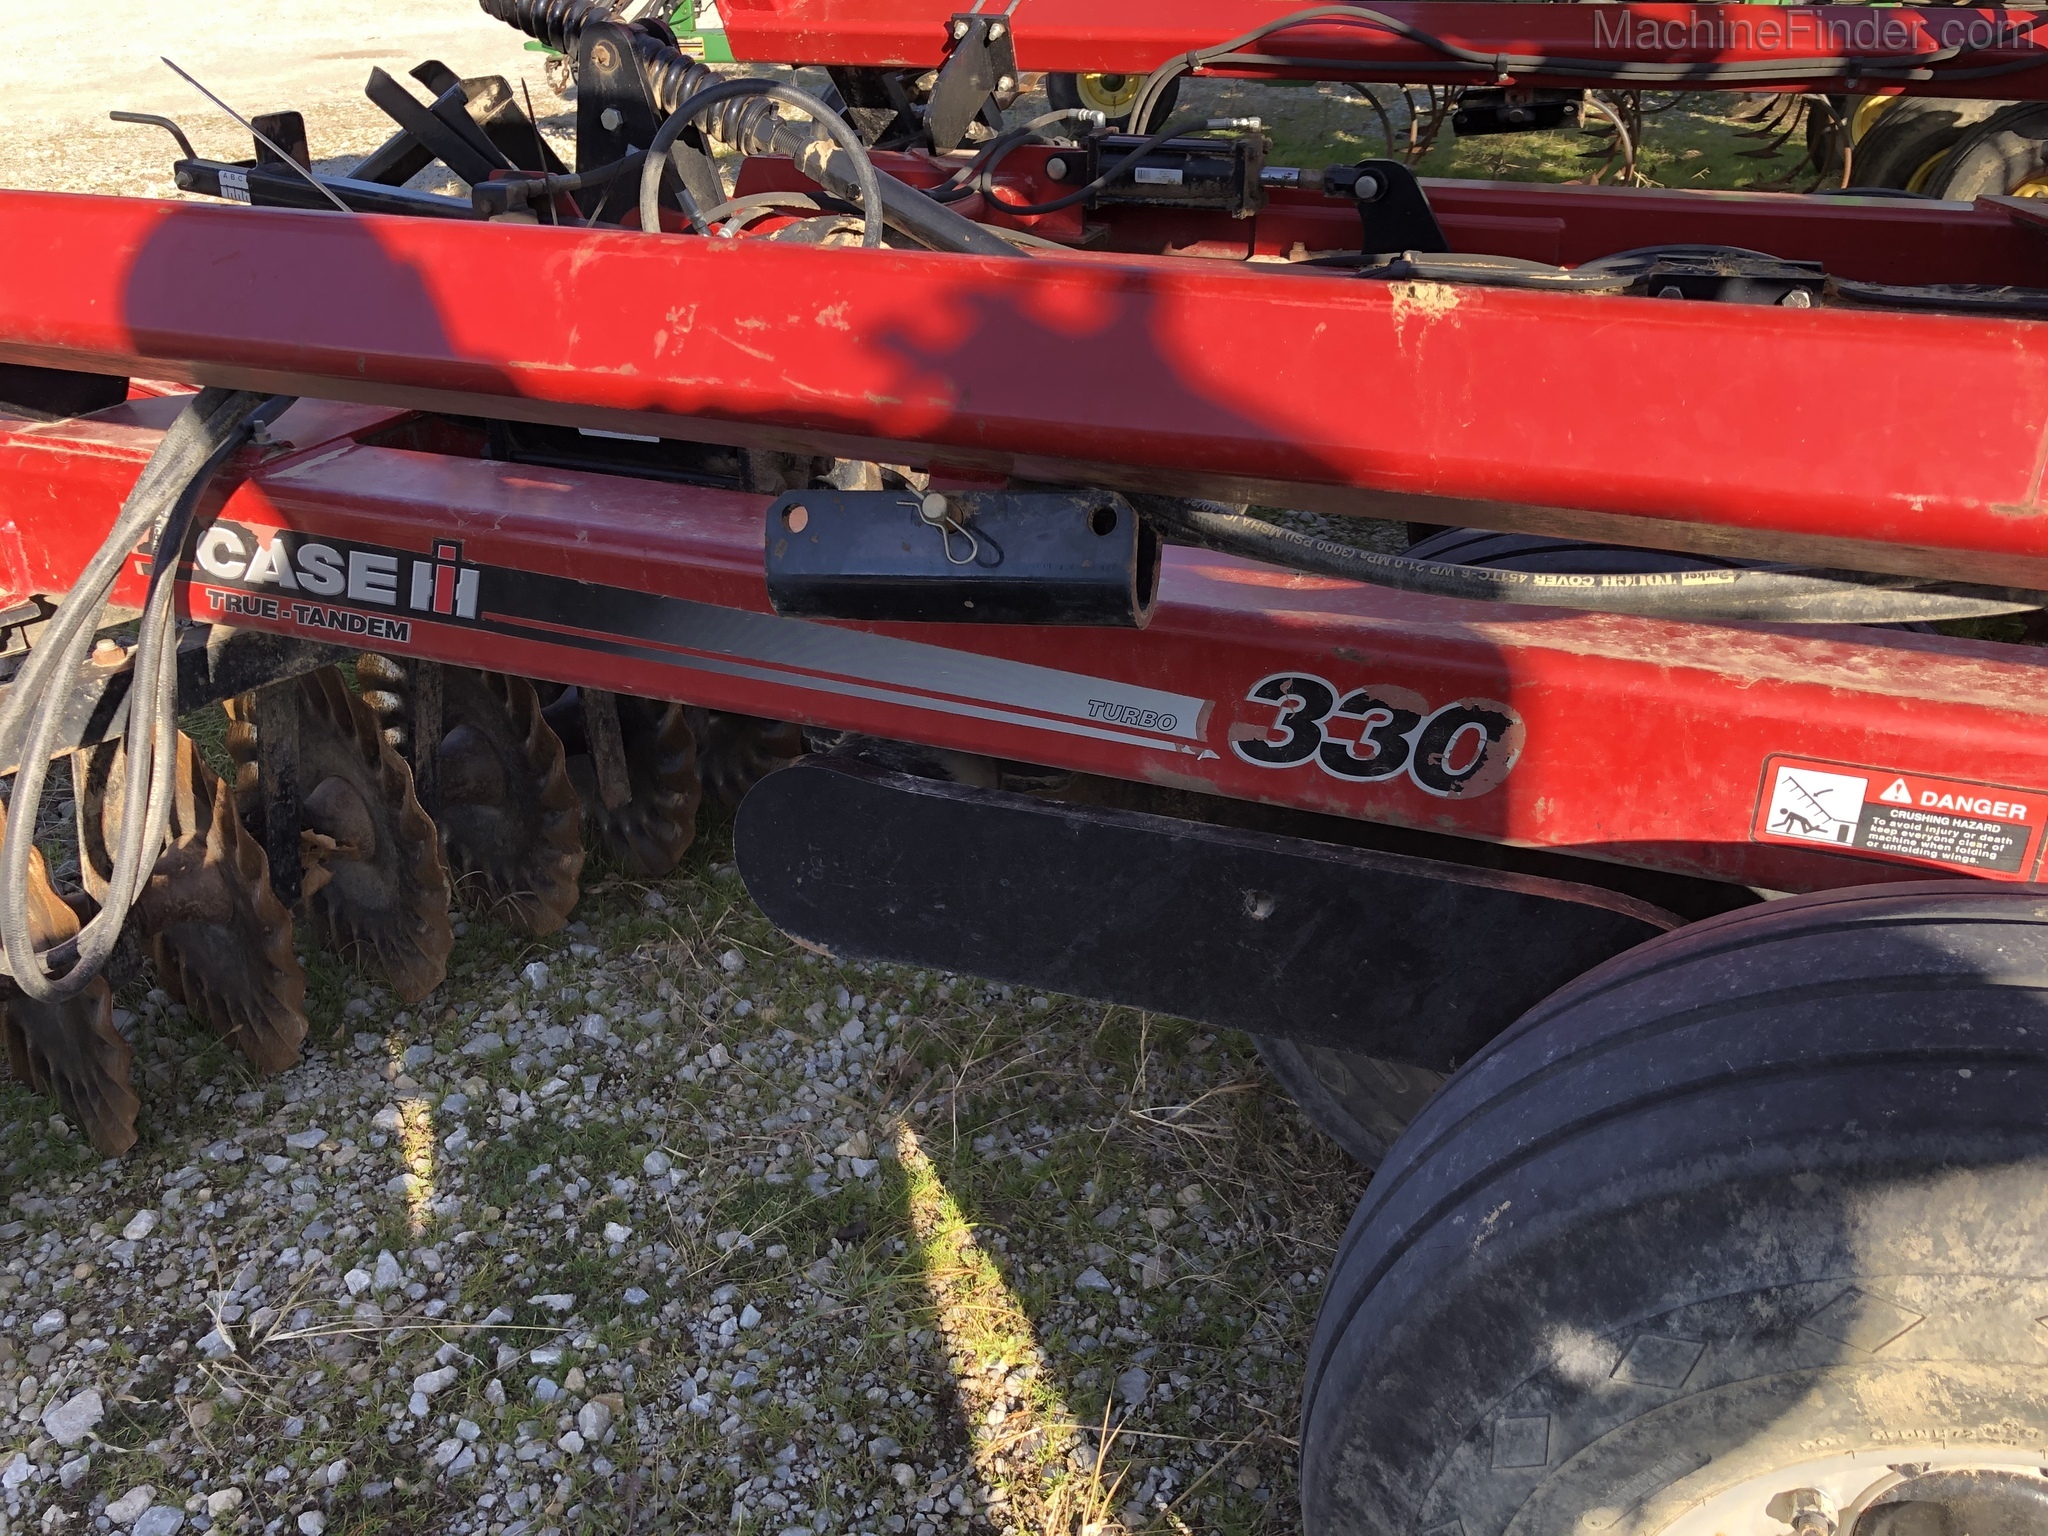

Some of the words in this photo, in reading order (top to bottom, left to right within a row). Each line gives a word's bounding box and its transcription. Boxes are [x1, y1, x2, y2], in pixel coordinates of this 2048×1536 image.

[1242, 516, 1285, 539] MSHA
[1285, 530, 1315, 549] PSI)
[1316, 541, 1356, 559] (3000
[196, 527, 398, 606] CASE
[1360, 552, 1391, 567] MPa
[1394, 560, 1426, 573] 21.0
[1429, 566, 1455, 578] WP
[1461, 569, 1528, 584] 451TC-6
[1533, 574, 1596, 588] COVER
[1600, 573, 1677, 588] TOUGH
[1088, 699, 1178, 732] TURBO
[1228, 672, 1526, 799] 330
[1920, 791, 2028, 821] DANGER
[1872, 816, 1886, 826] To
[1889, 820, 1922, 831] avoid
[1925, 825, 1959, 838] injury
[1963, 831, 1976, 839] or
[1979, 833, 2013, 845] death
[1890, 809, 1950, 826] CRUSHING
[1952, 818, 2001, 833] HAZARD
[1868, 833, 1917, 846] machine
[1921, 841, 1951, 851] when
[1955, 845, 1998, 860] folding
[1870, 824, 1898, 836] keep
[1901, 830, 1955, 845] everyone
[1958, 838, 1988, 849] clear
[1992, 844, 2005, 852] of
[1866, 840, 1879, 848] or
[1882, 842, 1938, 859] unfolding
[1942, 851, 1980, 865] wings.
